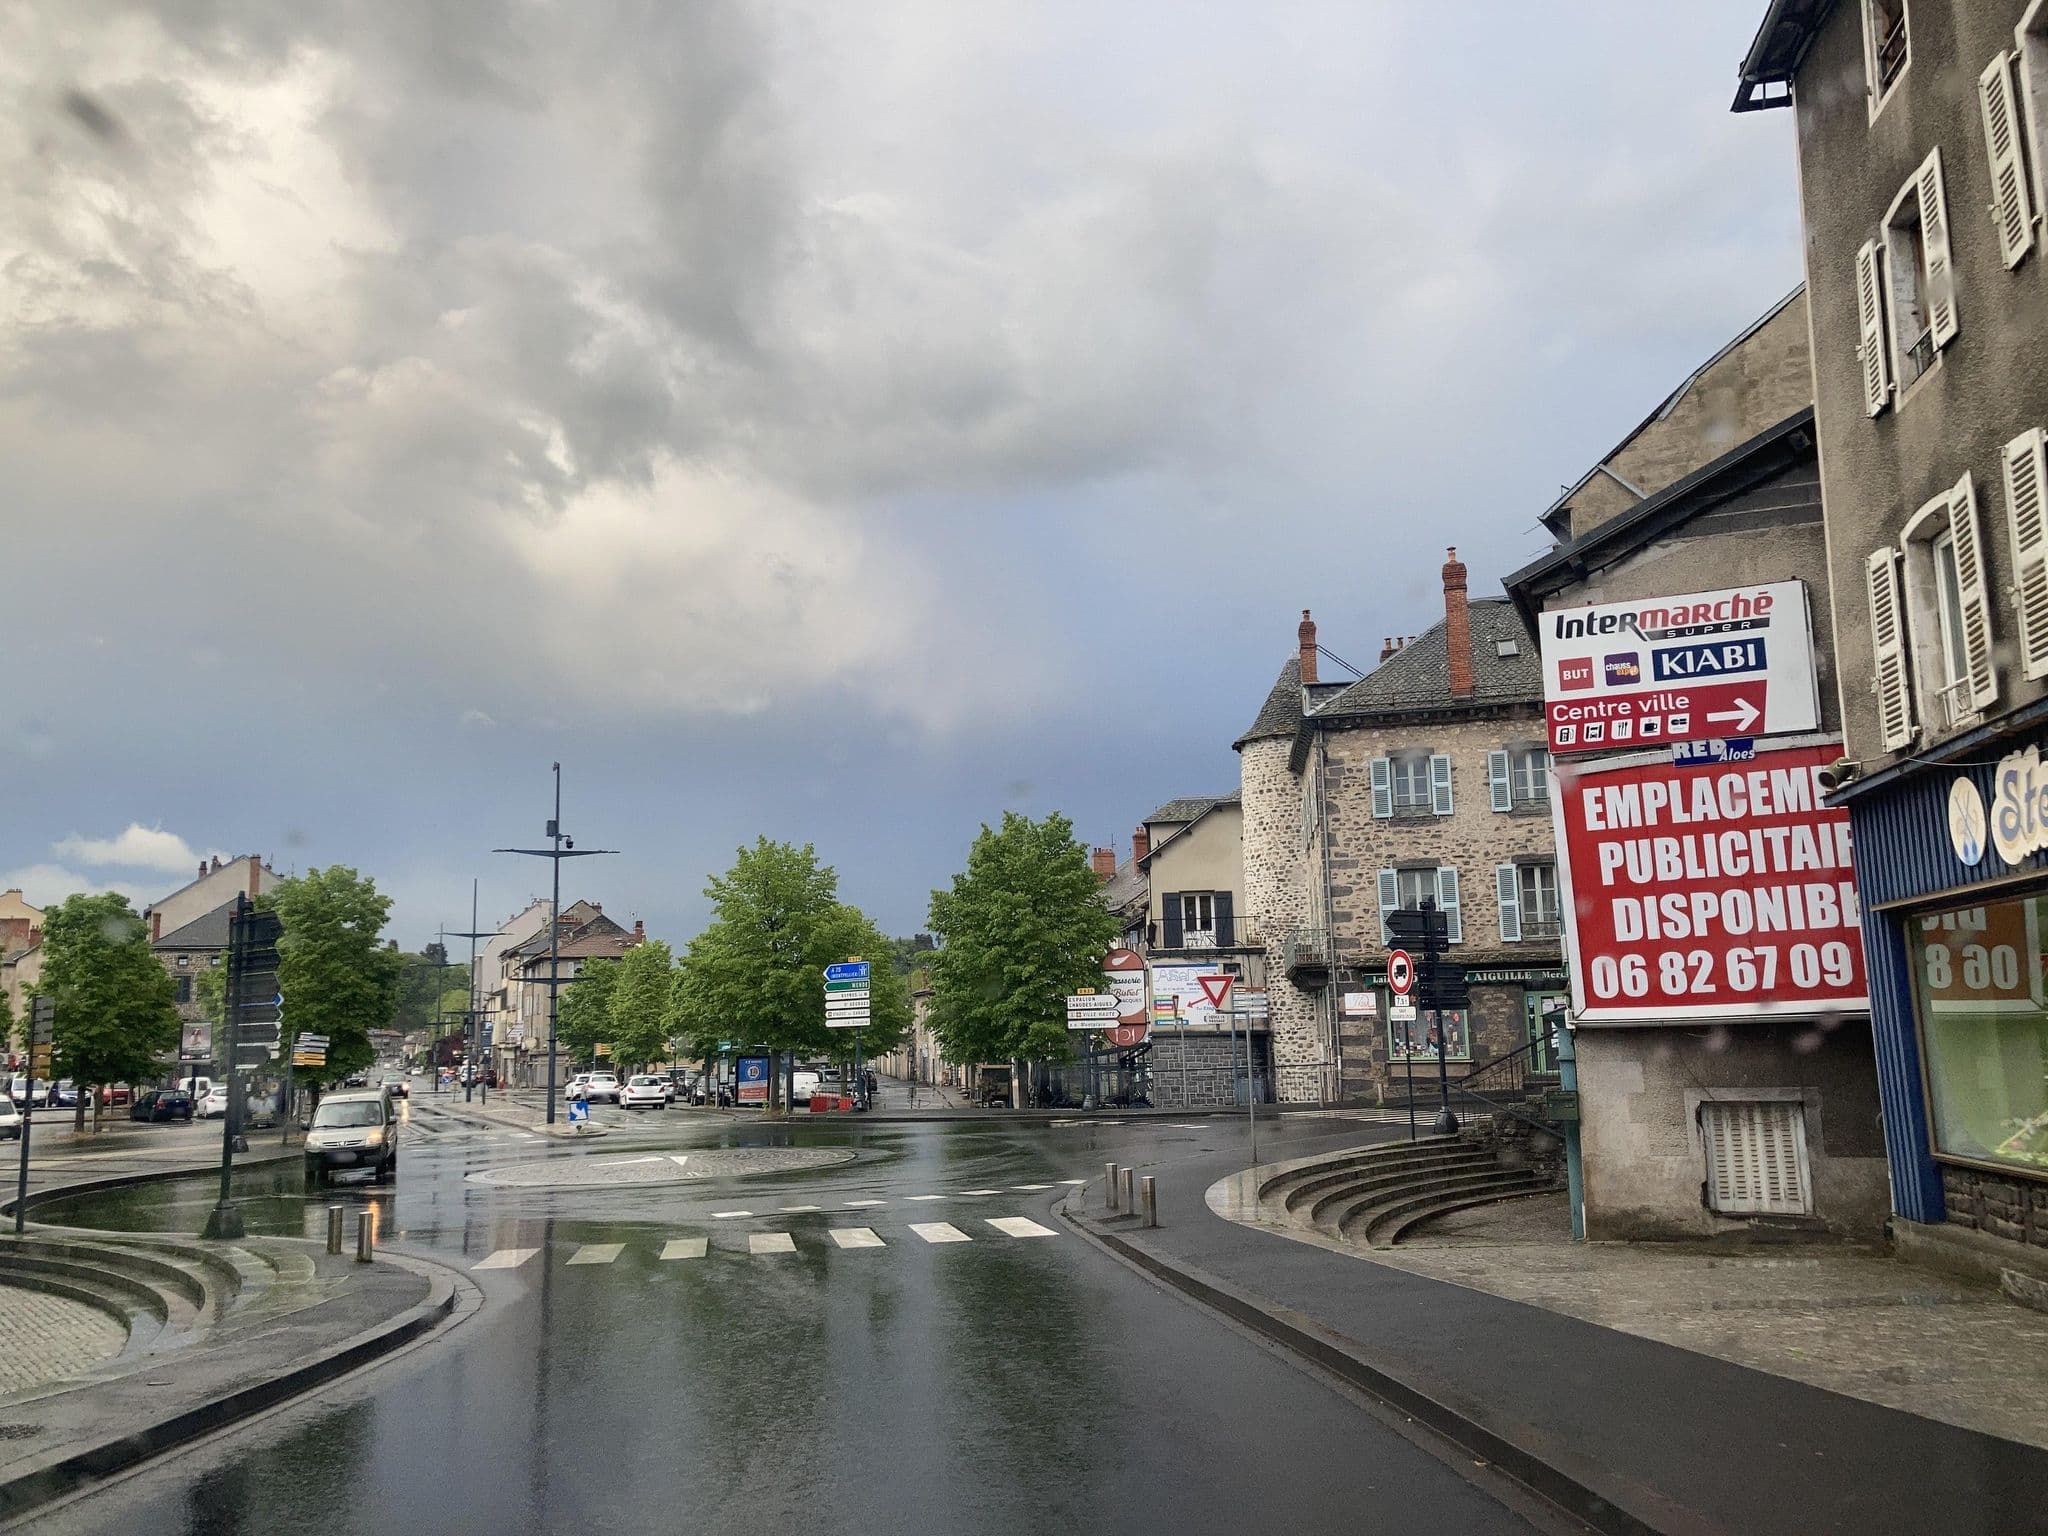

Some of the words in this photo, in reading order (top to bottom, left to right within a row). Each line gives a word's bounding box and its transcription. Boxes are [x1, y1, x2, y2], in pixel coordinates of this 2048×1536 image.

[1555, 591, 1773, 641] Intermarché
[1563, 668, 1589, 680] BUT
[1661, 644, 1756, 675] KIABI
[1553, 699, 1631, 721] Centre
[1638, 693, 1690, 712] ville
[1719, 747, 1755, 762] Aloes
[1612, 881, 1860, 942] DISPONIBL
[1474, 971, 1532, 981] AIGUILLE
[1591, 953, 1649, 999] 06
[1658, 949, 1716, 995] 82
[1725, 945, 1778, 992] 67
[1790, 941, 1853, 988] 09
